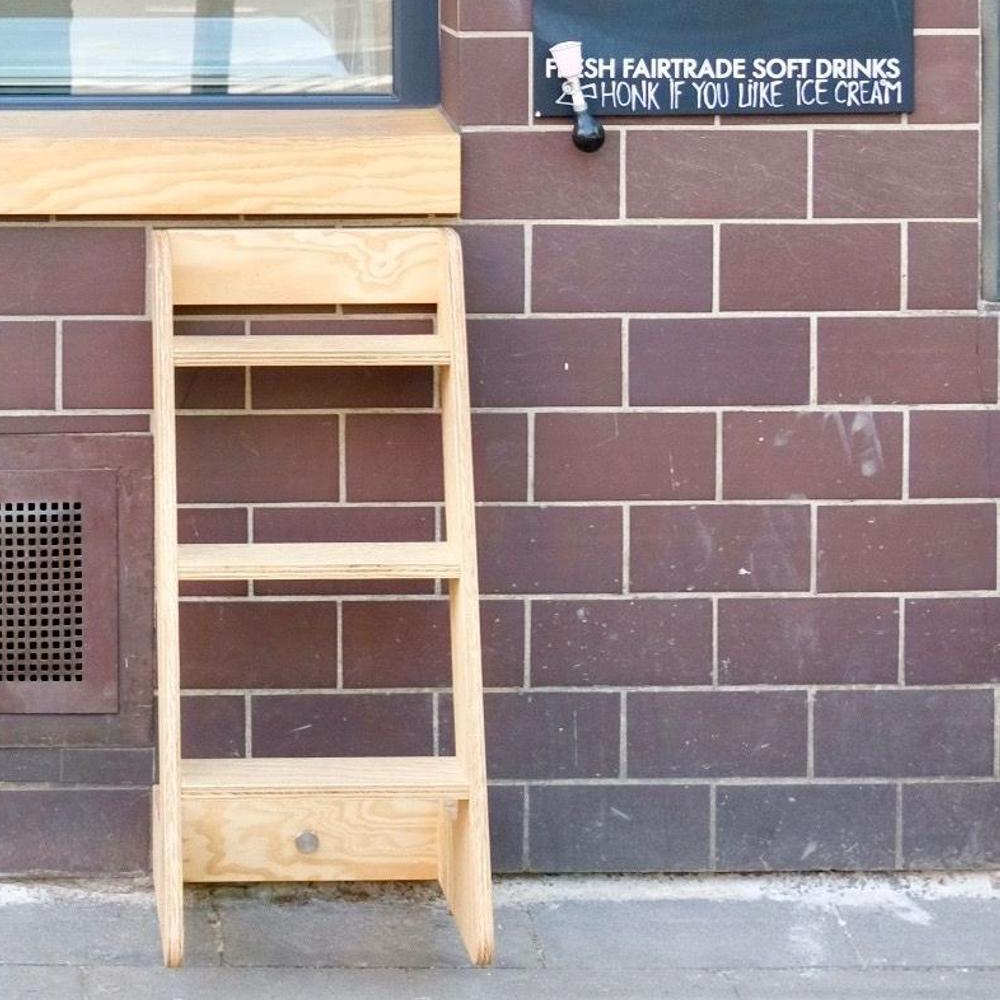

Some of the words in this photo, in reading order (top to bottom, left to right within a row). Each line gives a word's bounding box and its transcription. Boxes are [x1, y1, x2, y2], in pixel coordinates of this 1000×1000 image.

[545, 57, 616, 79] FSH
[623, 57, 746, 79] FAIRTRADE
[752, 57, 811, 79] SOFT
[816, 57, 901, 79] DRINKS
[601, 80, 660, 111] HONK
[669, 77, 686, 109] IF
[691, 81, 729, 109] YOU
[796, 79, 829, 106] ICE
[834, 80, 902, 107] CREAM
